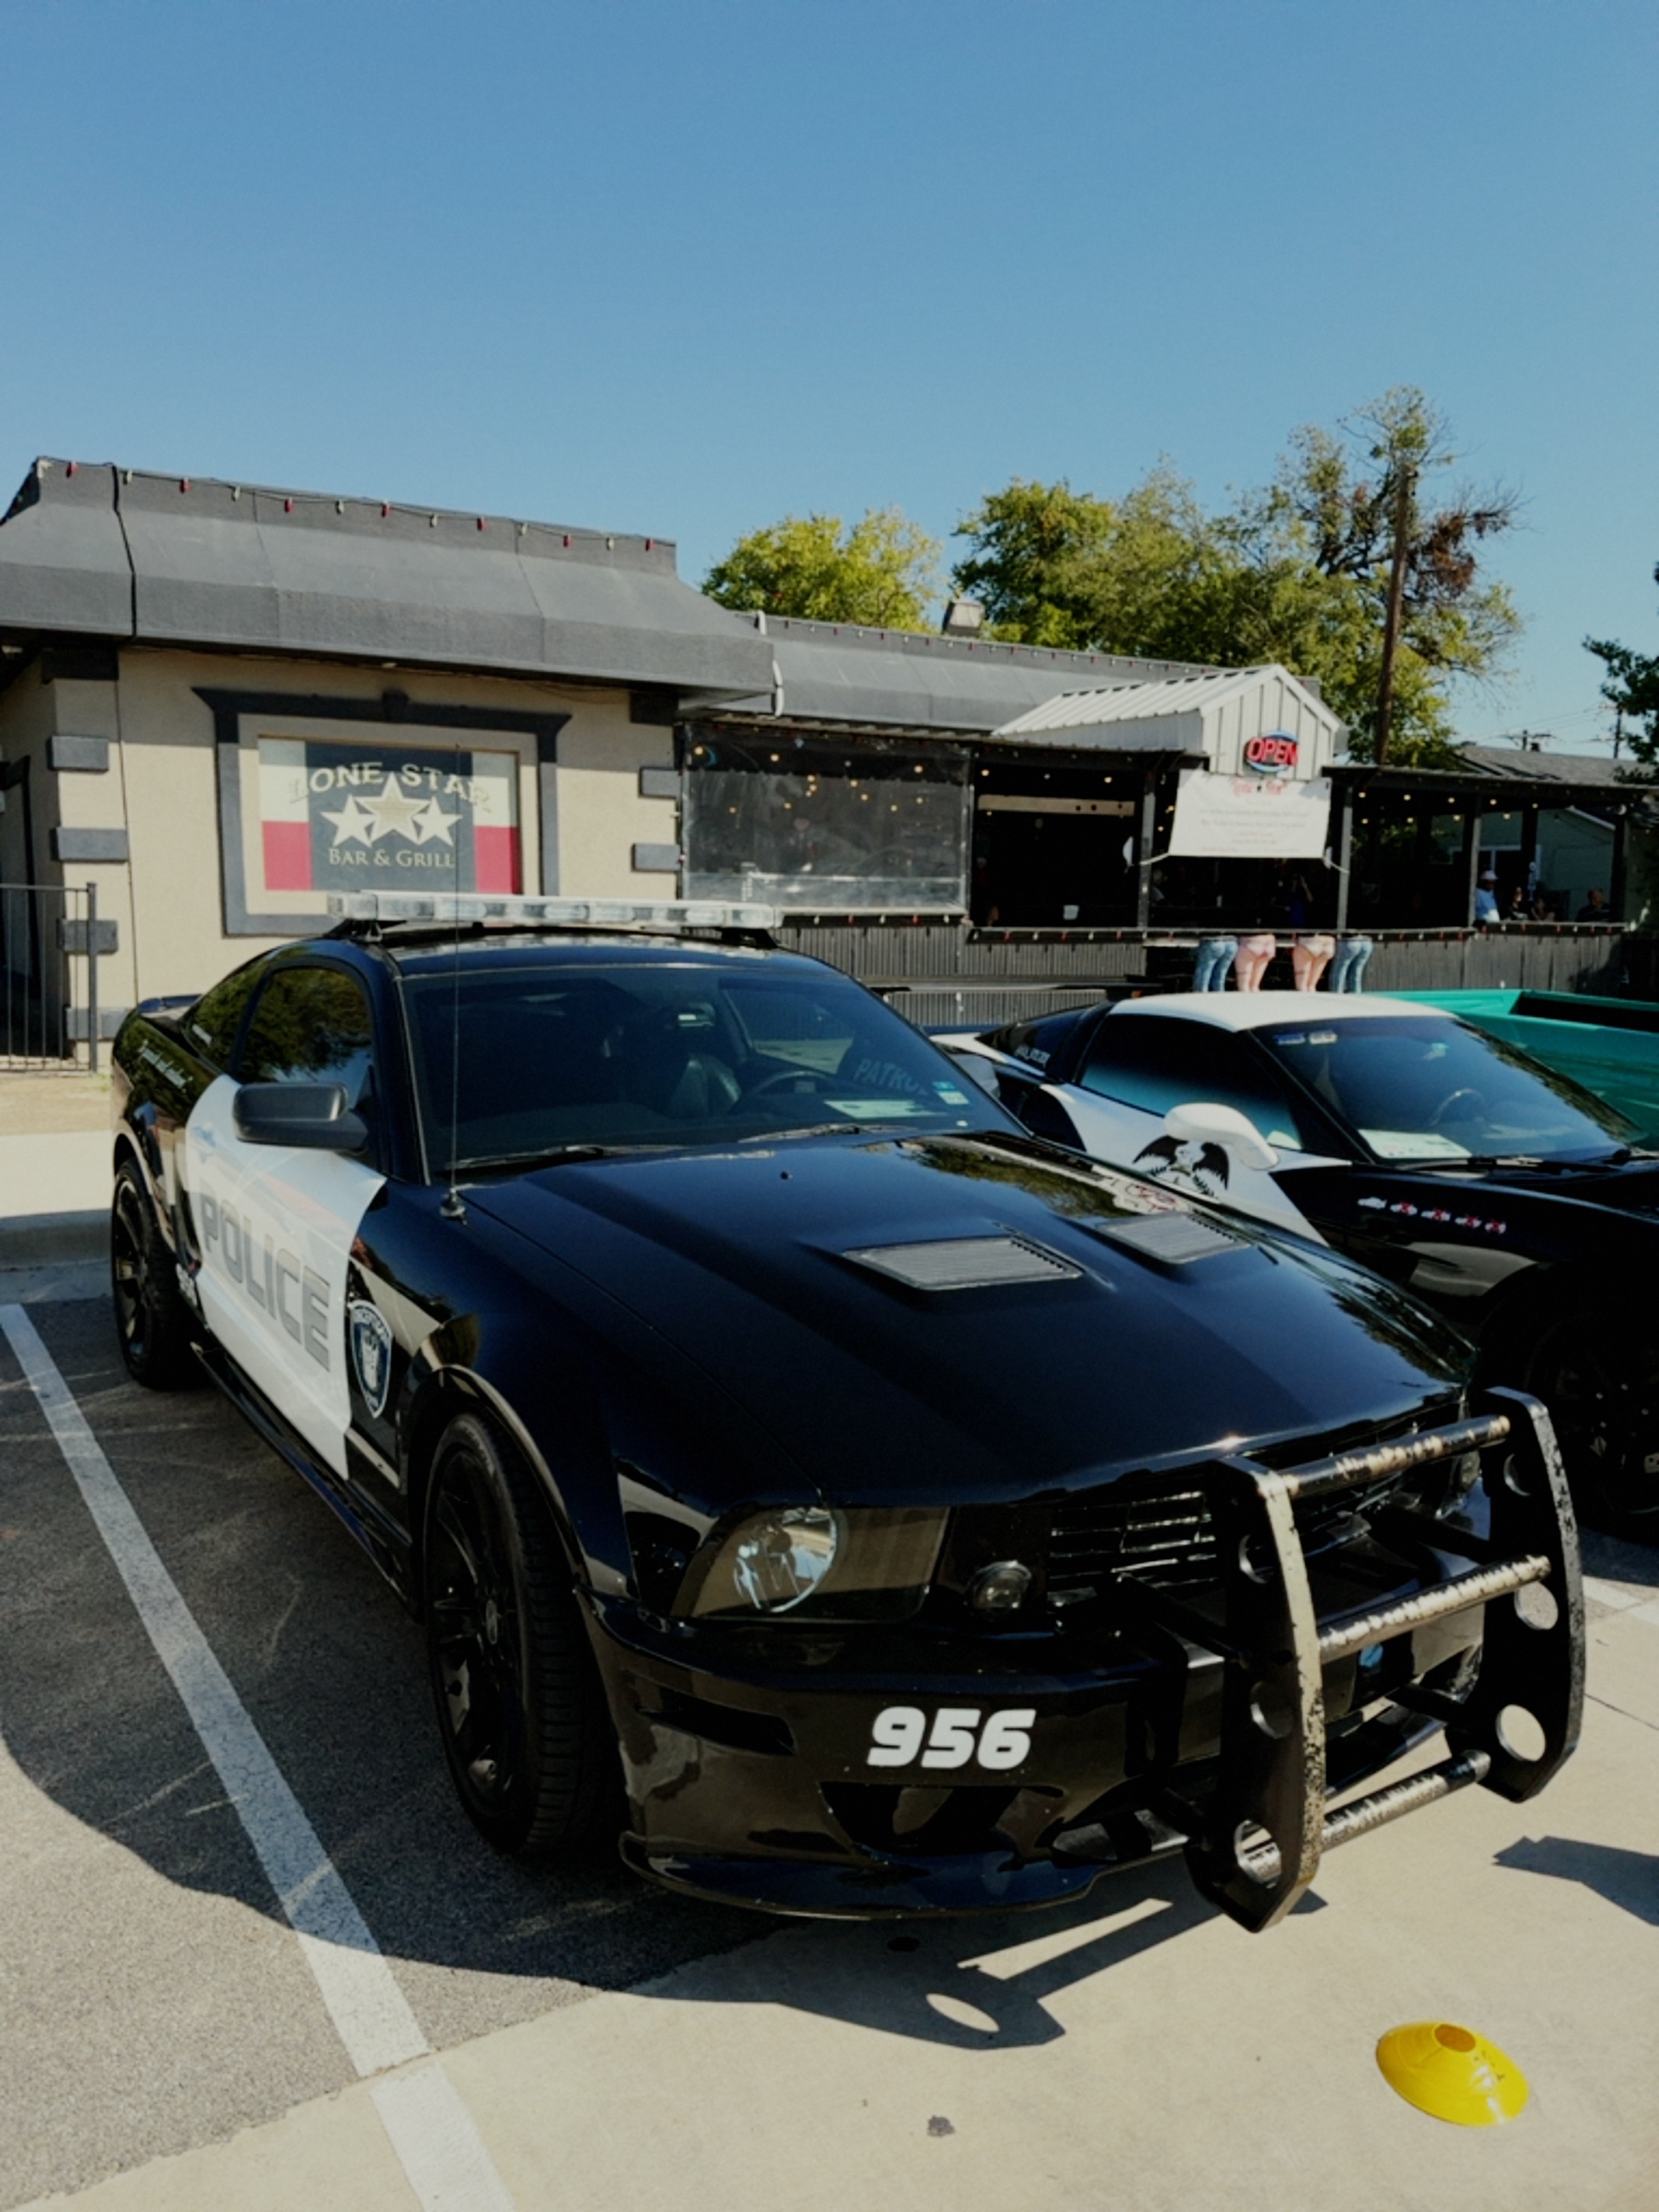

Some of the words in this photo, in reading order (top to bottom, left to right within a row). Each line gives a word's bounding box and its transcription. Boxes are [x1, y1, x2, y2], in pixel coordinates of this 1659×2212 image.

[1246, 737, 1298, 766] OPEN
[329, 848, 369, 865] BAR
[374, 849, 391, 866] &
[396, 850, 455, 868] GRILL
[853, 1059, 929, 1096] PATRO
[200, 1180, 331, 1373] POLICE
[866, 1706, 1036, 1770] 956
